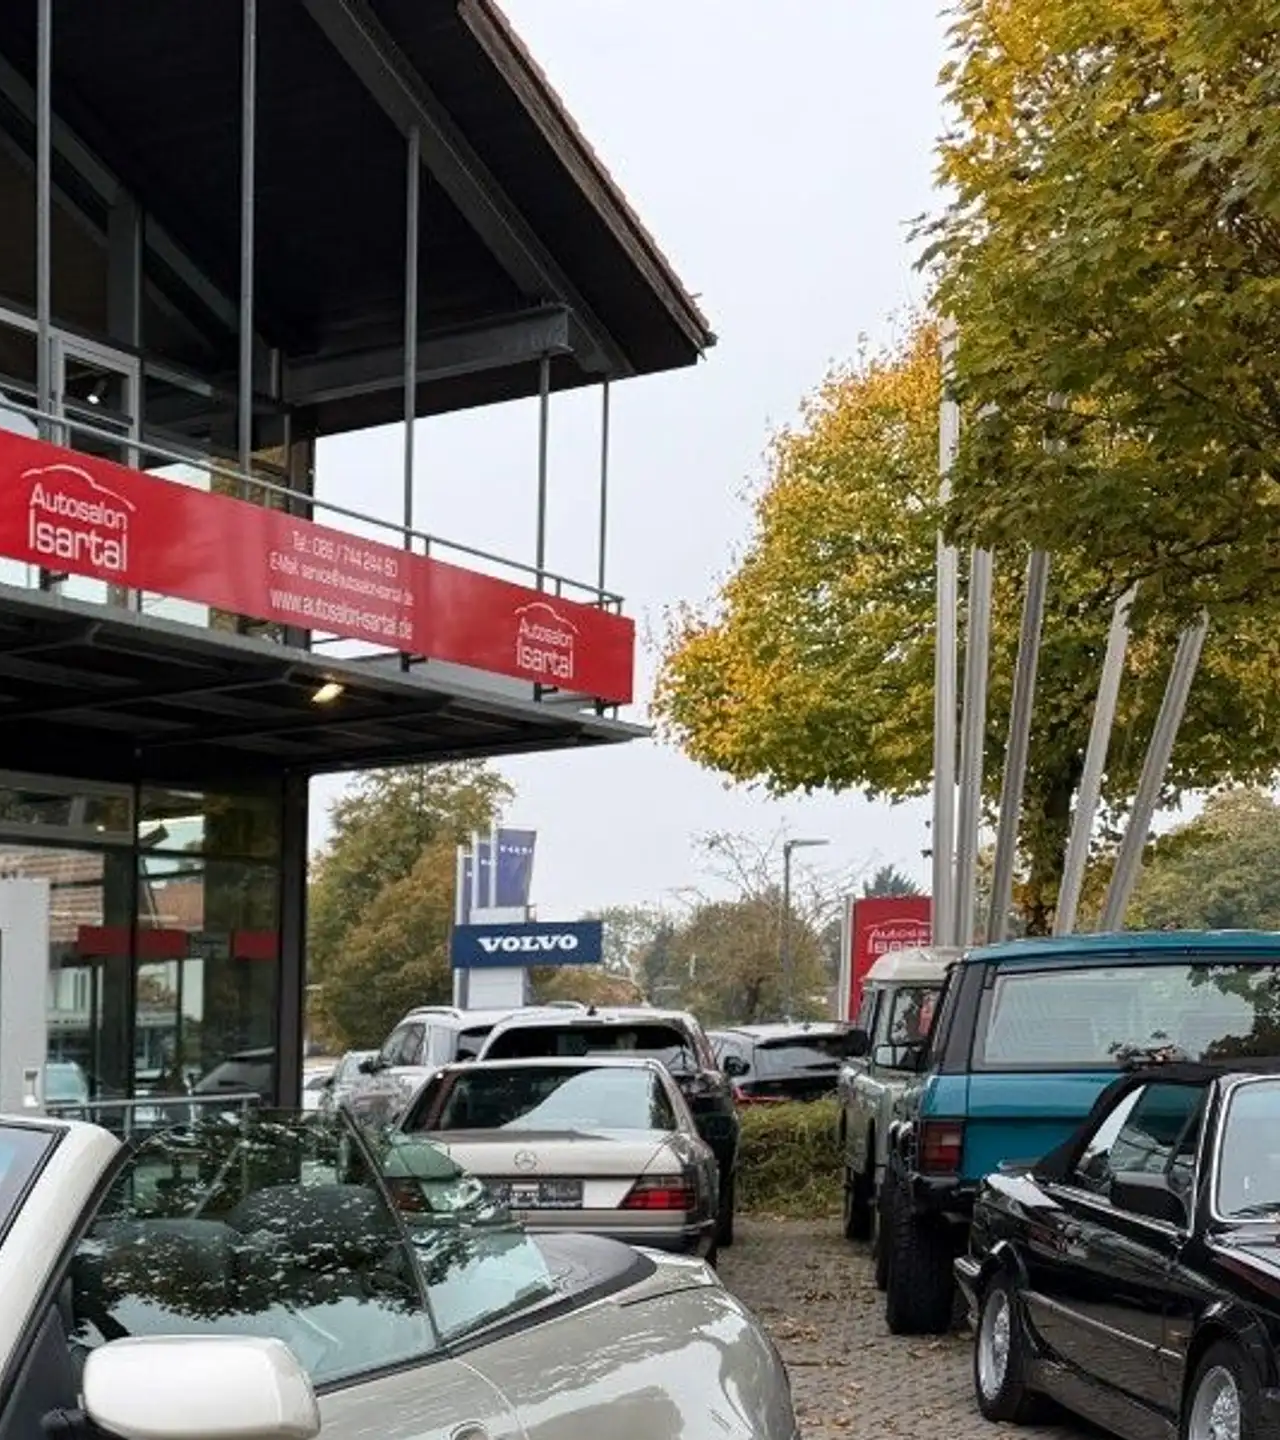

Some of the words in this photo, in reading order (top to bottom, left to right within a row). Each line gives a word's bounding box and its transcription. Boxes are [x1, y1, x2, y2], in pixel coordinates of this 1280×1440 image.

[29, 482, 128, 531] Autosalon
[29, 508, 128, 573] Isartal
[269, 588, 414, 640] www.autosalon-isartal.de
[519, 616, 574, 649] Autosalon
[516, 637, 574, 680] Isartal
[476, 934, 579, 953] VOLVO
